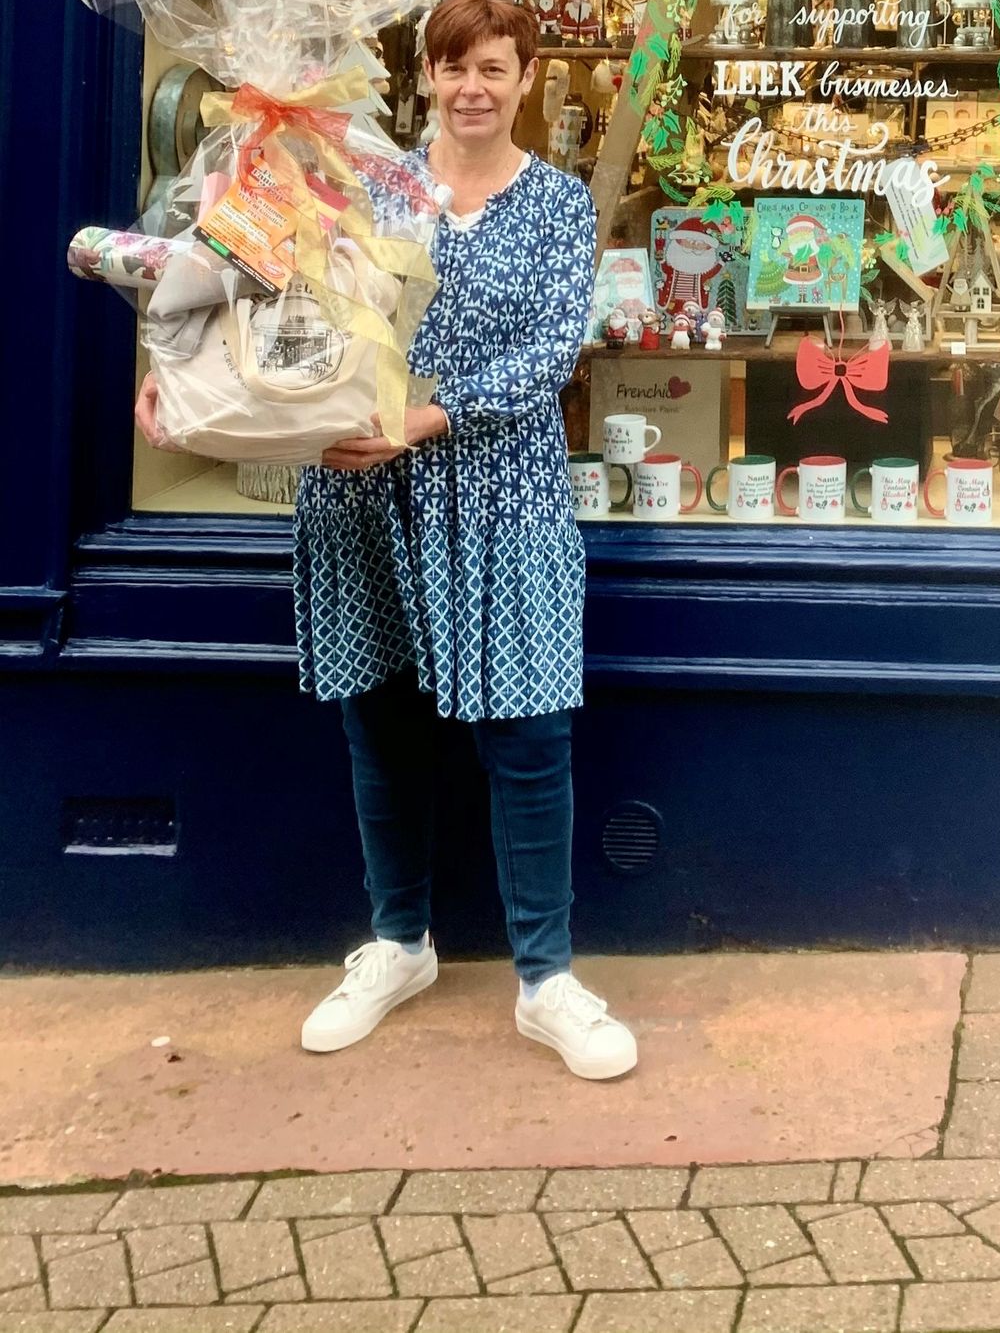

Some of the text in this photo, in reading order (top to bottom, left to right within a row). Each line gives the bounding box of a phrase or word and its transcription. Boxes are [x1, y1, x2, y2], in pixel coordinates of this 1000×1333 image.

[722, 3, 766, 41] for
[713, 60, 959, 98] LEEK businesses
[790, 102, 858, 132] this
[720, 117, 951, 206] Christmas
